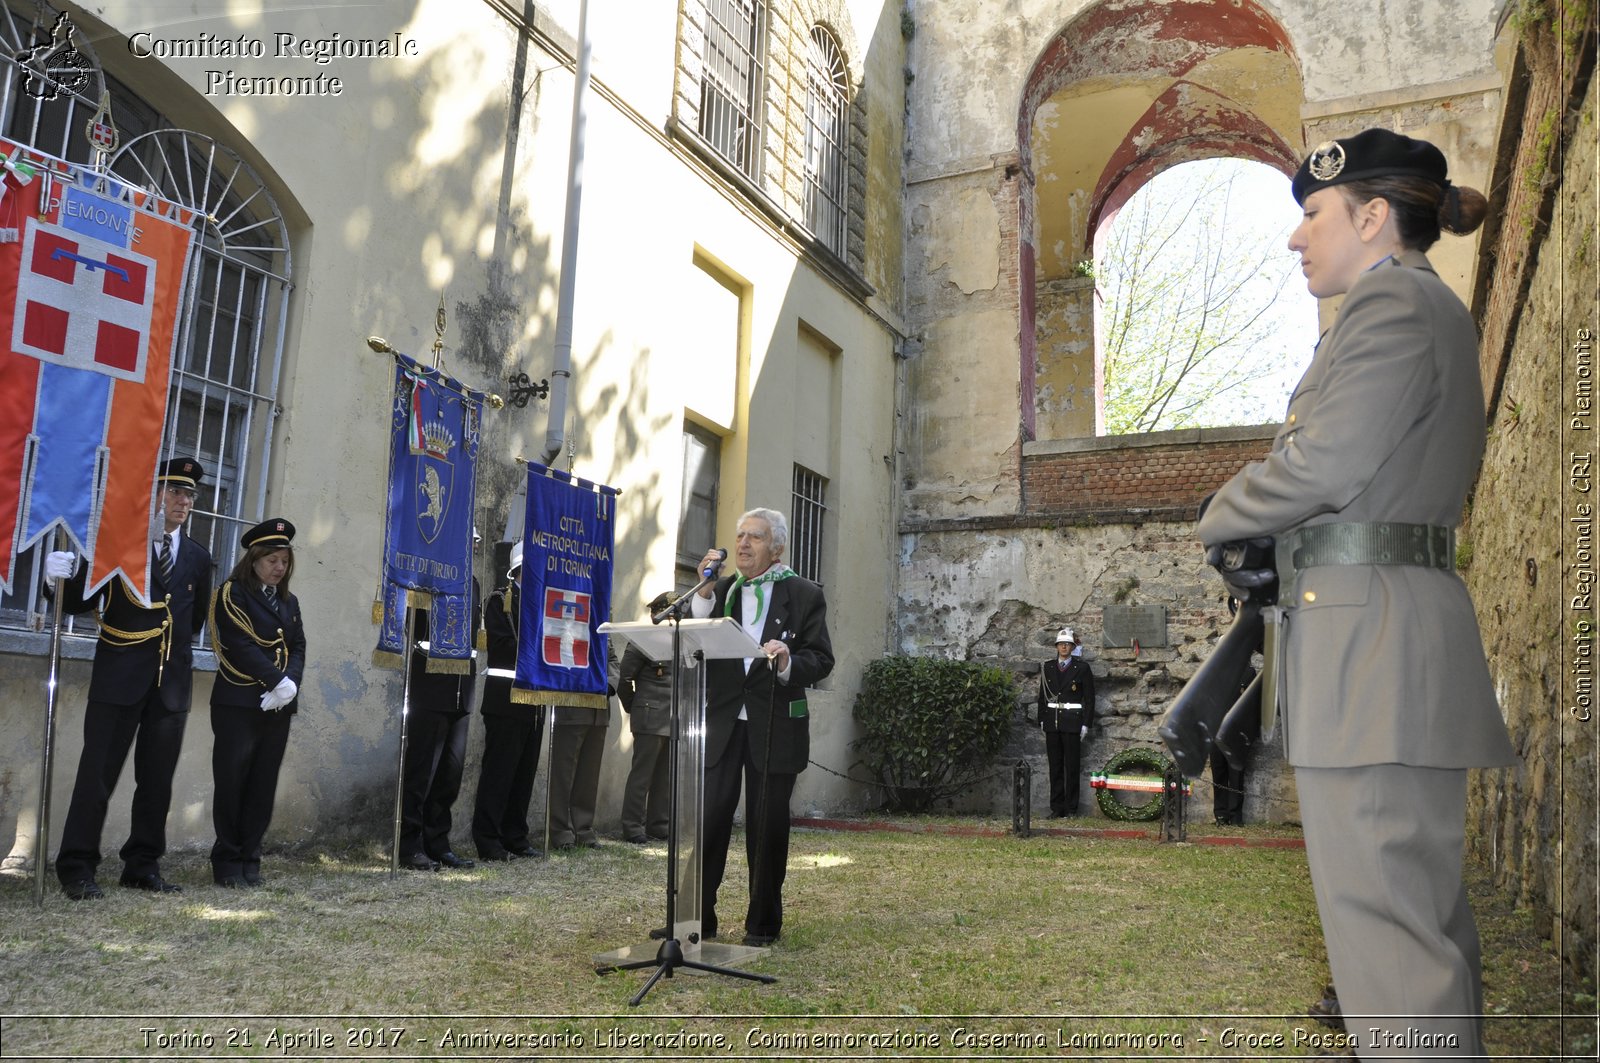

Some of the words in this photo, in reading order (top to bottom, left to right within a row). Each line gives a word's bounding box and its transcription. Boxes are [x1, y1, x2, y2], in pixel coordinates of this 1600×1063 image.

[49, 198, 144, 244] PIEMONTE
[532, 529, 610, 562] METROPOLITANA
[418, 557, 429, 574] DI
[430, 559, 458, 580] TORINO
[547, 555, 558, 572] DI
